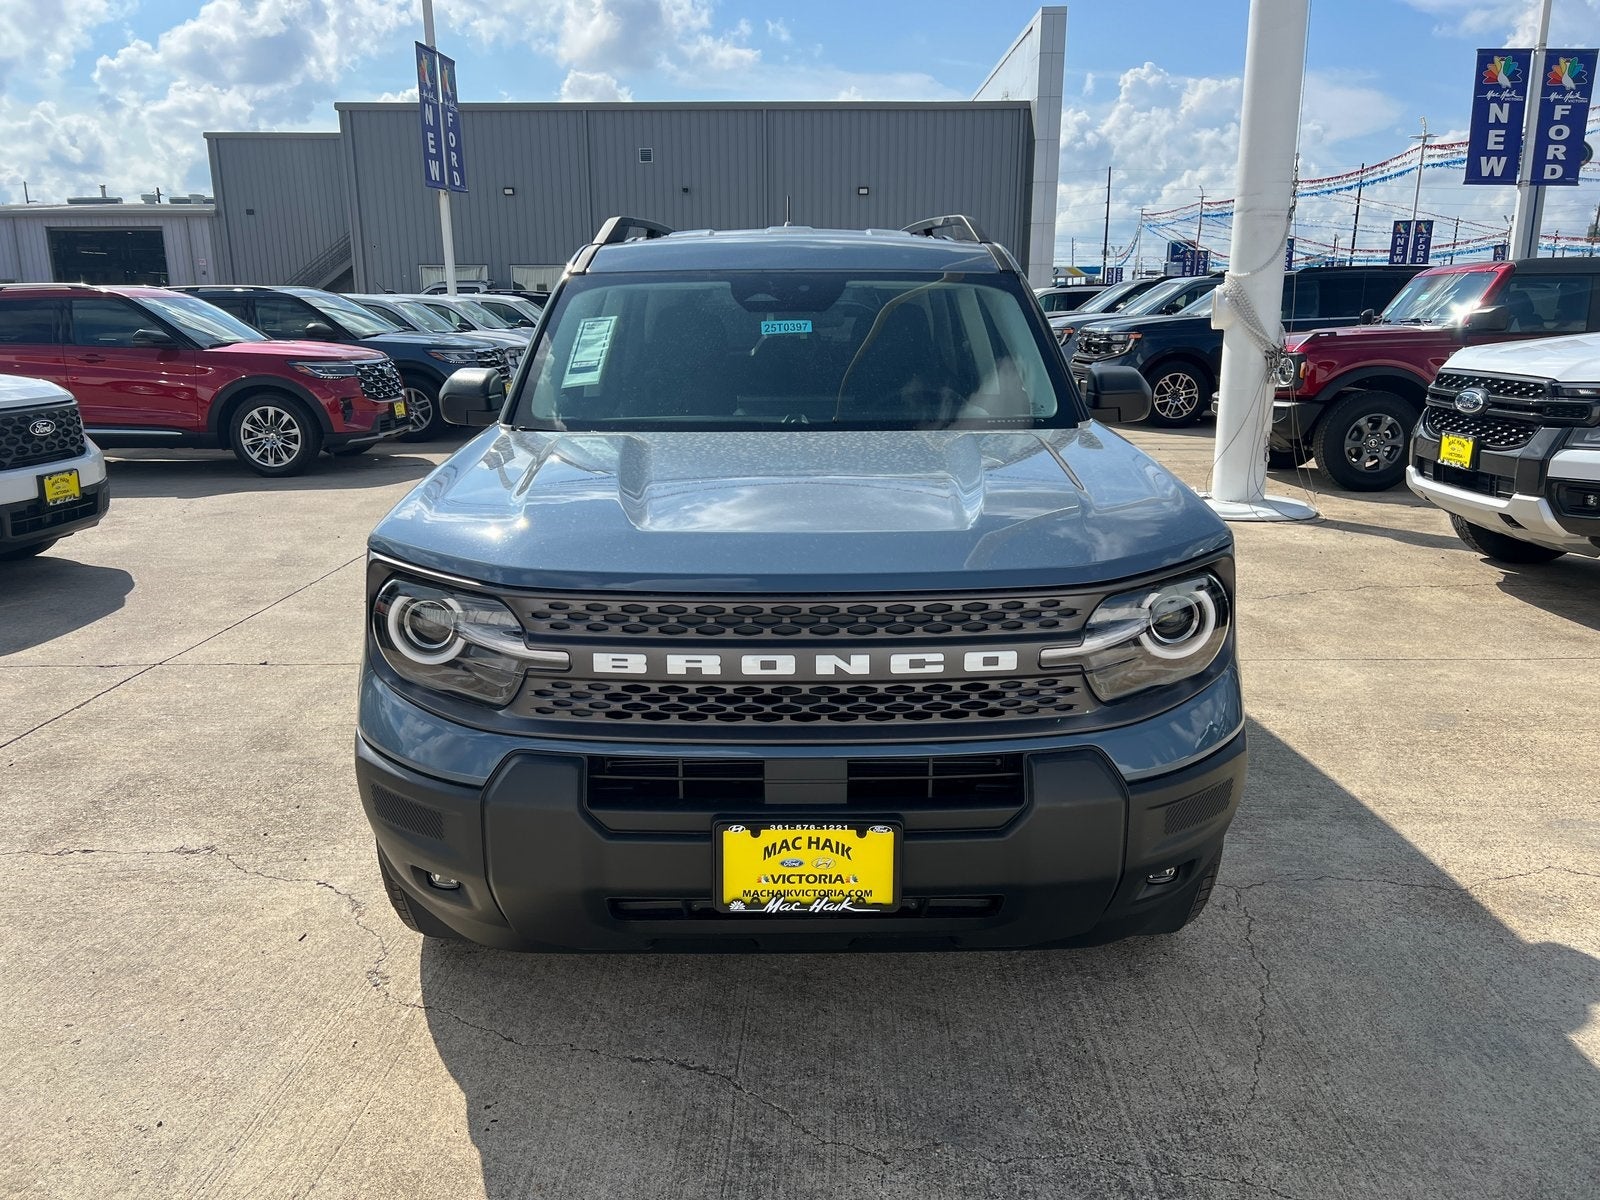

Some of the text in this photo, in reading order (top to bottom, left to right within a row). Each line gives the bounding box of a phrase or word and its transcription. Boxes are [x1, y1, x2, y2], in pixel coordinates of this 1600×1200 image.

[424, 103, 440, 182] NEW
[446, 112, 461, 187] FORD
[1480, 103, 1510, 177] NEW
[1543, 104, 1572, 180] FORD
[1393, 237, 1405, 263] NEW
[1415, 237, 1426, 263] FORD
[764, 322, 808, 333] 25T0397
[34, 421, 52, 434] Ford
[592, 650, 1018, 676] BRONCO
[763, 836, 852, 861] MAC HAIK
[781, 859, 802, 868] Ford
[770, 874, 845, 884] VICTORIA
[742, 889, 873, 898] MACHAIKVICTORIA.COM
[764, 896, 855, 913] Mac Haik
